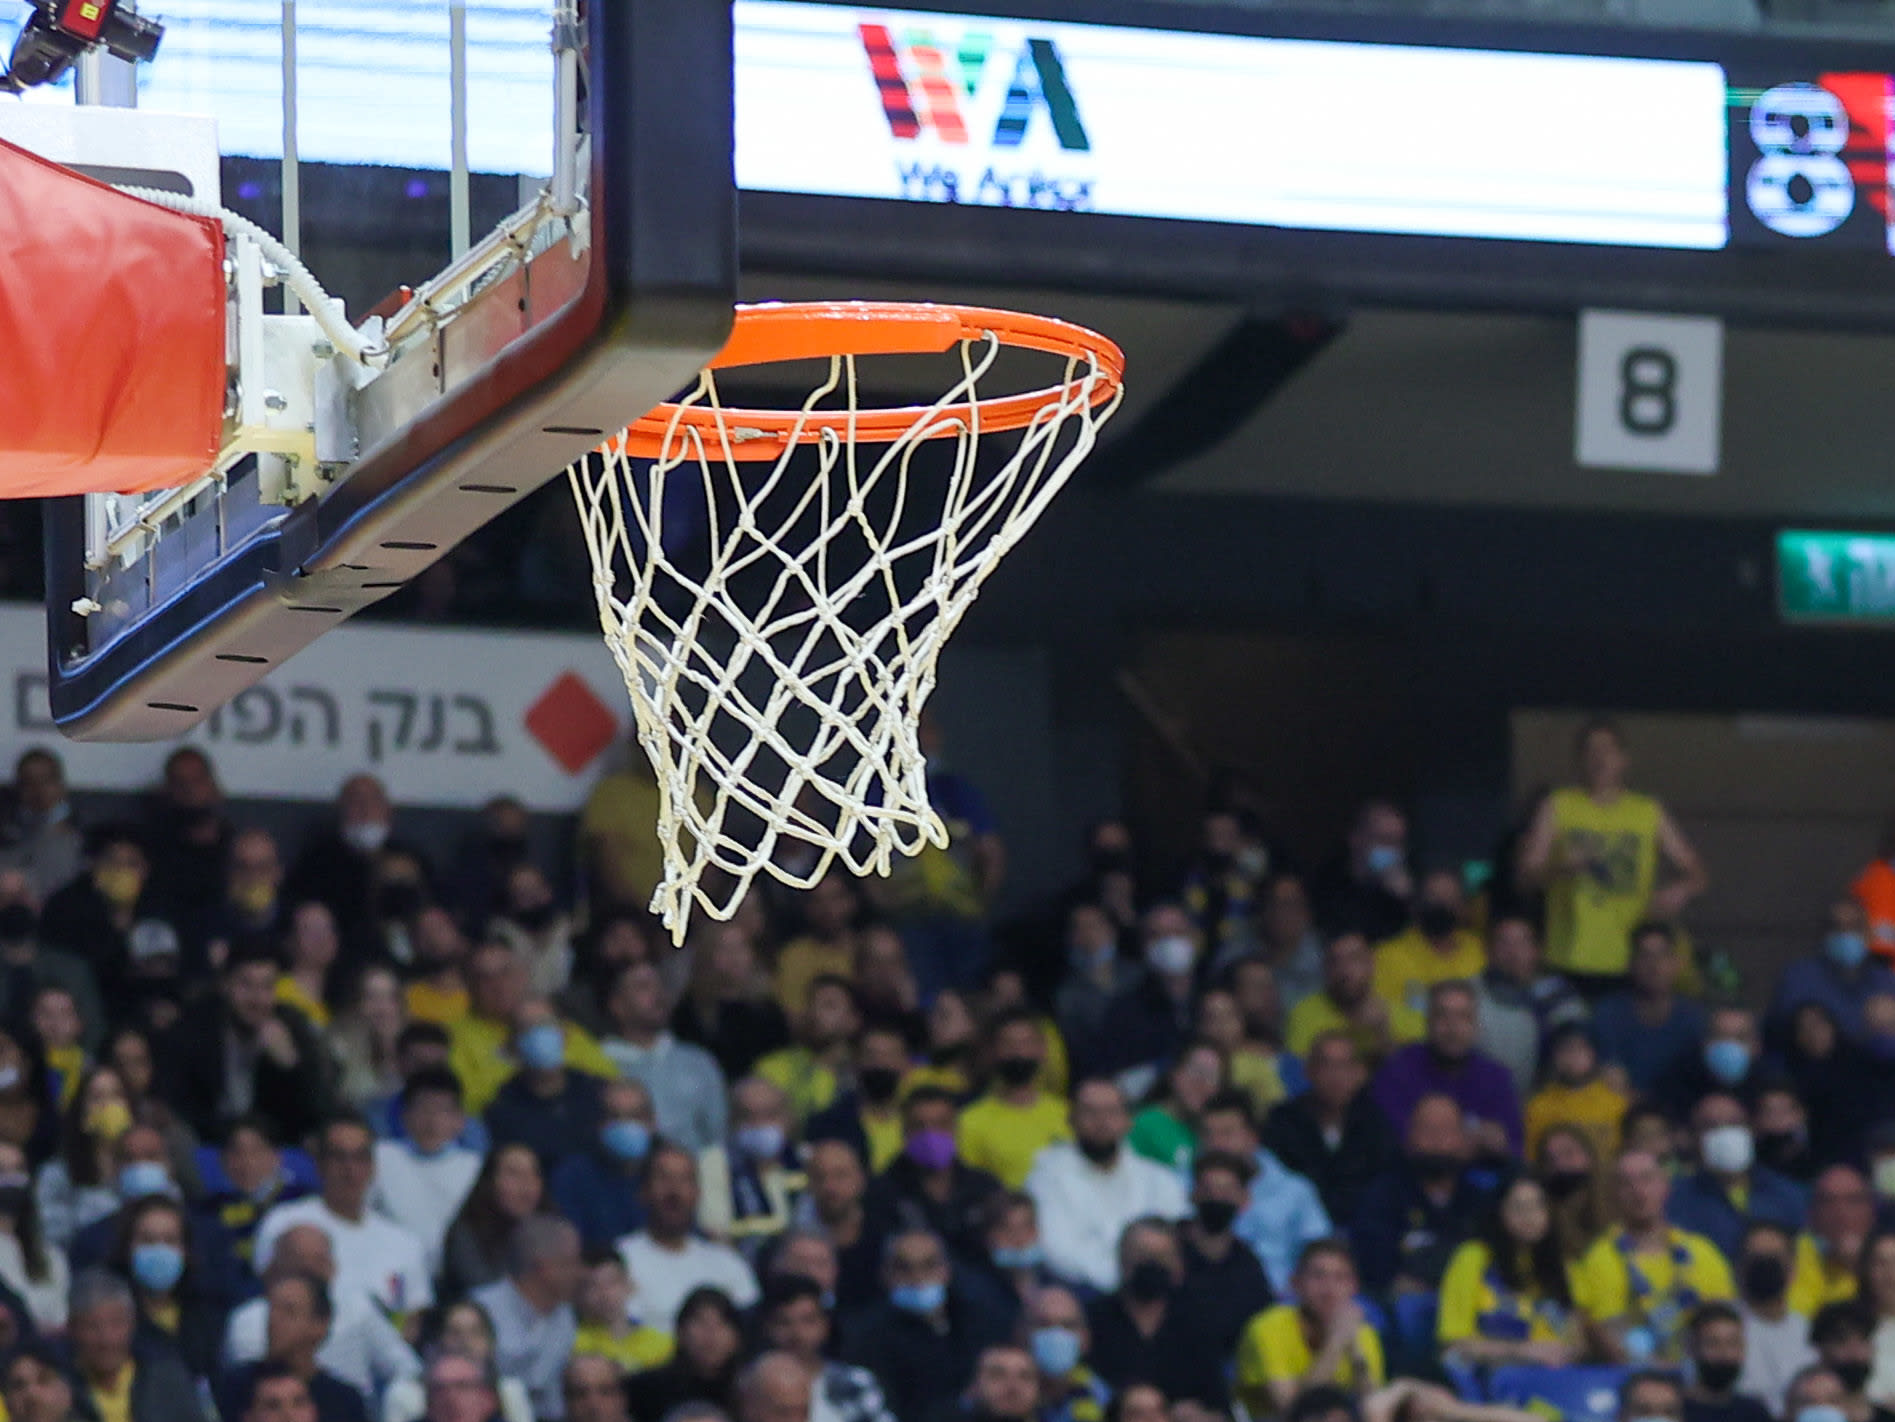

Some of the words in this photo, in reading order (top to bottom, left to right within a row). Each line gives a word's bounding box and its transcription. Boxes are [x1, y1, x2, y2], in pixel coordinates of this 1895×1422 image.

[1745, 82, 1856, 238] 8
[1621, 346, 1677, 438] 8
[366, 689, 502, 764] בנק
